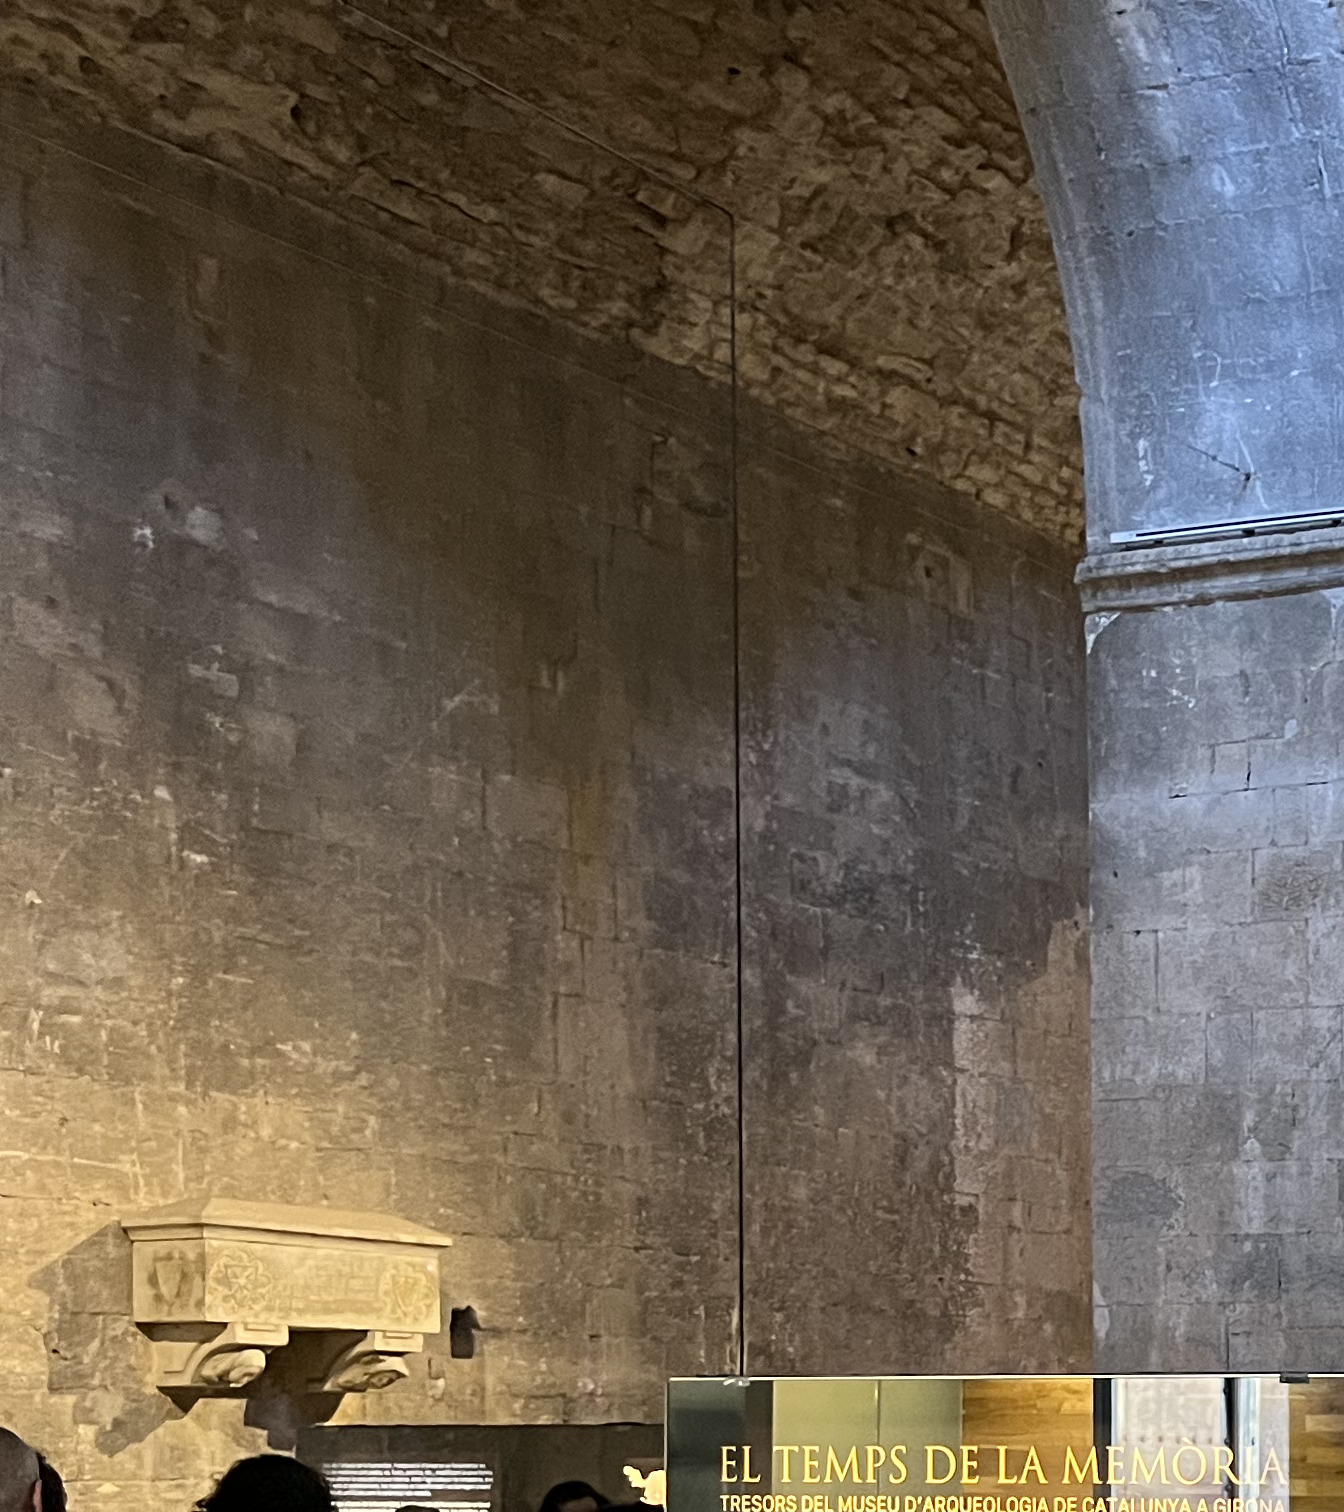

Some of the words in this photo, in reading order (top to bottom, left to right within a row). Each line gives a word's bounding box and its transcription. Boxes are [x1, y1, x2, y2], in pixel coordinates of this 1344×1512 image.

[720, 1445, 761, 1484] EL
[773, 1445, 908, 1484] TEMPS
[925, 1445, 980, 1484] DE
[997, 1445, 1048, 1485] LA
[1062, 1437, 1287, 1485] MEMÒRIA
[719, 1495, 797, 1512] TRESORS
[801, 1495, 834, 1512] DEL
